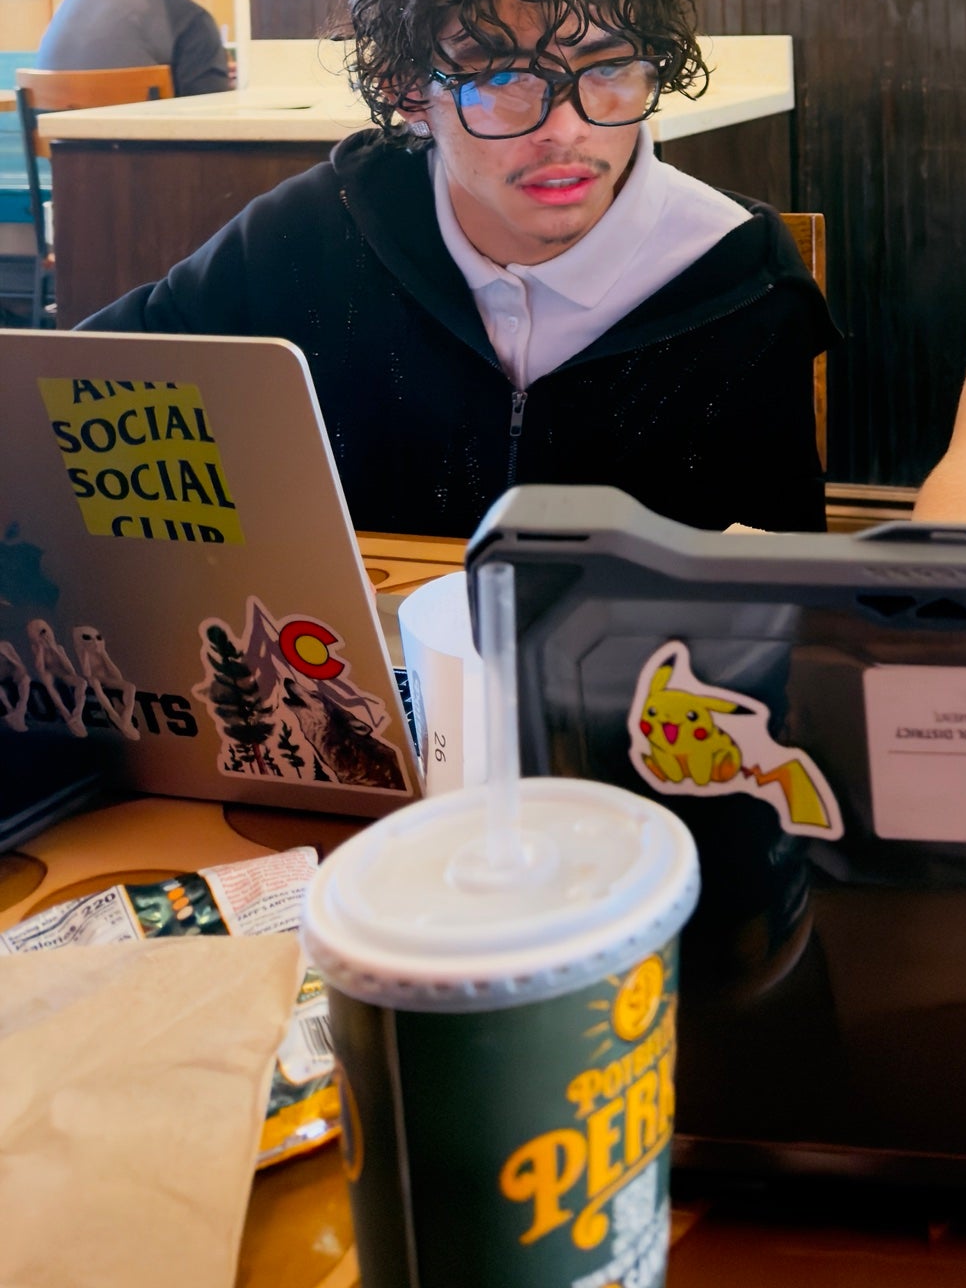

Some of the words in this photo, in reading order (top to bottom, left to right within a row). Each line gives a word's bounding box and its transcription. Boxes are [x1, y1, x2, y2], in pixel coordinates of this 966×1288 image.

[52, 406, 215, 453] SOCIAL
[67, 460, 236, 509] SOCIAL
[434, 731, 447, 763] 26
[896, 727, 954, 740] DISTRICT
[81, 892, 116, 918] 220
